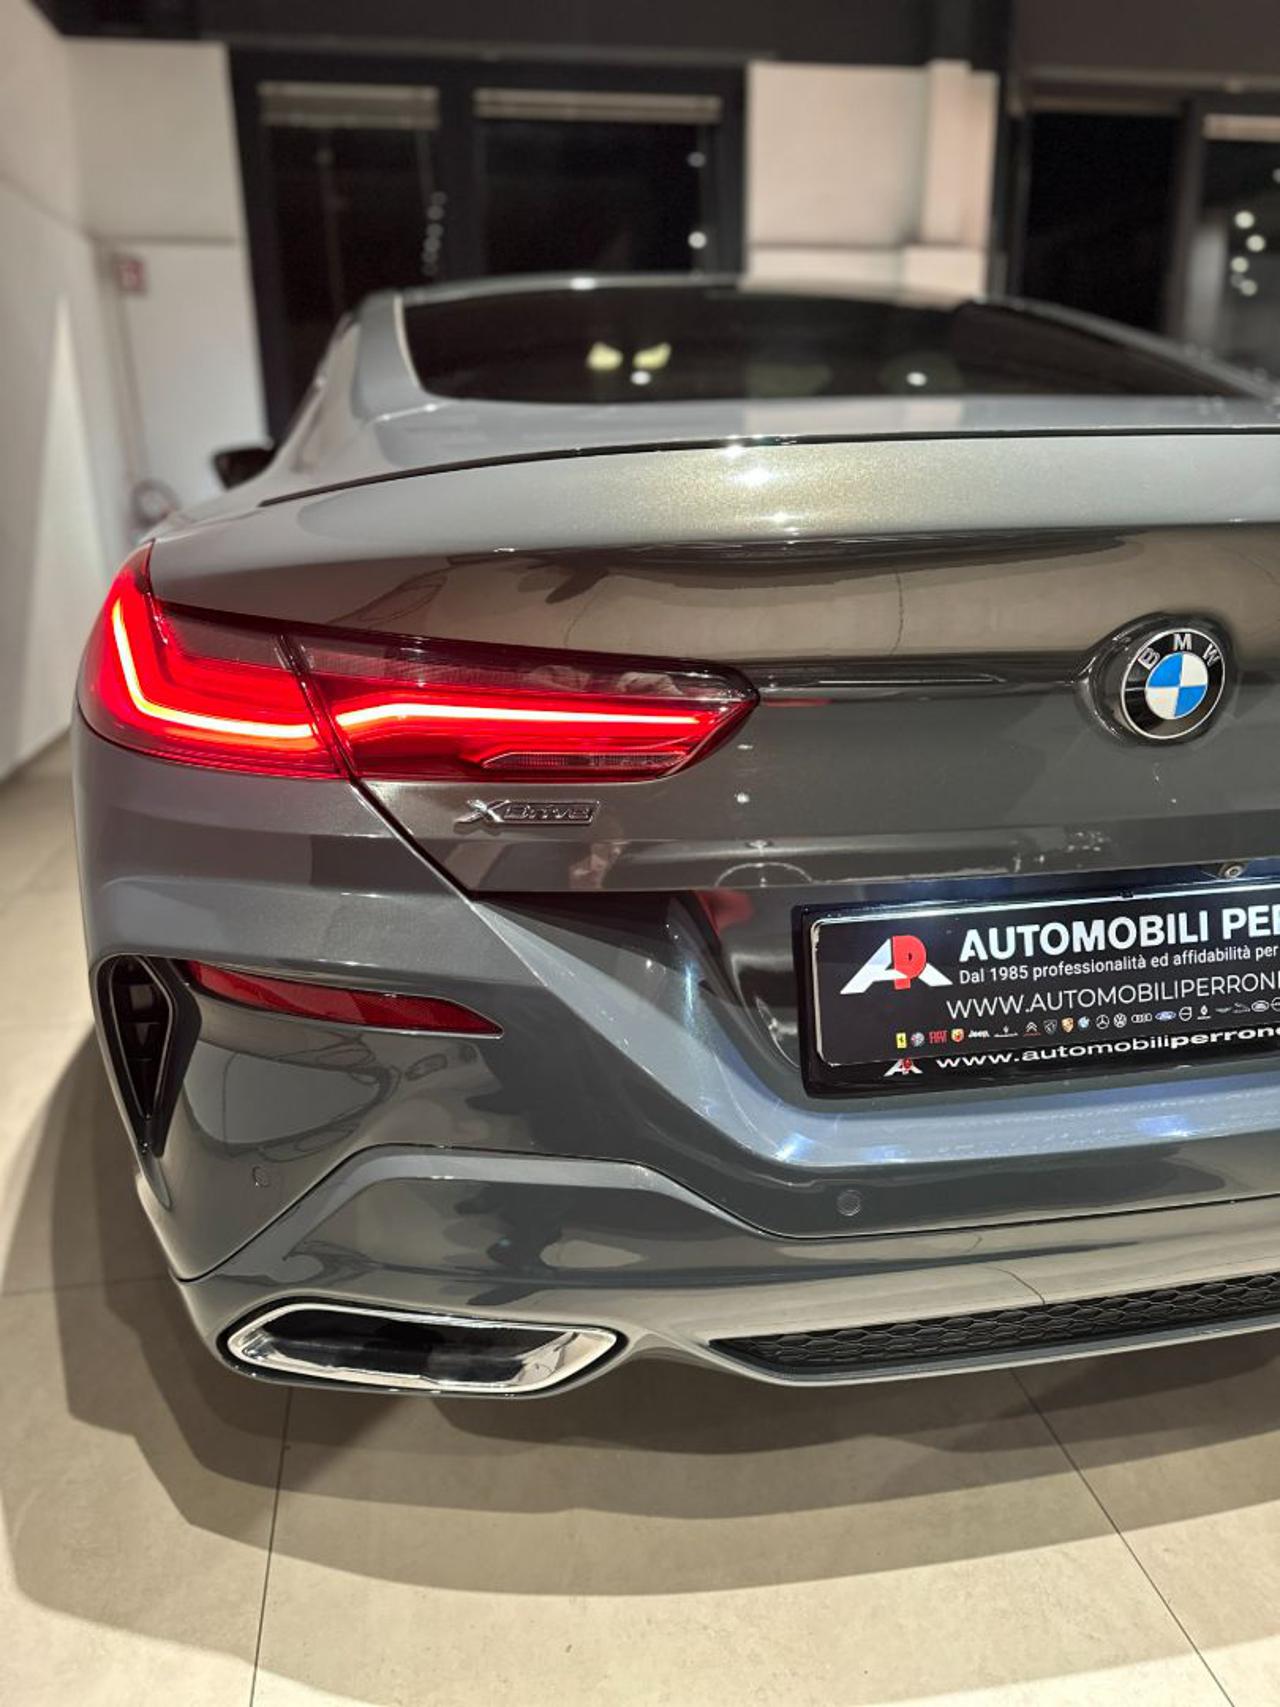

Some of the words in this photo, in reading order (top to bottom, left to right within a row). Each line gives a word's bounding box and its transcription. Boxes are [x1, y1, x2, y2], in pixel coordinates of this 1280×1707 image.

[1137, 633, 1220, 670] BMW
[958, 910, 1209, 963] AUTOMOBILI
[959, 968, 985, 984] Dal
[990, 965, 1029, 981] 1985
[1033, 954, 1147, 981] professionalità
[1151, 953, 1169, 968] ed
[1173, 945, 1251, 966] affidabilità
[1255, 945, 1279, 961] per
[946, 970, 1280, 1020] WWW.AUTOMOBILIPERRON
